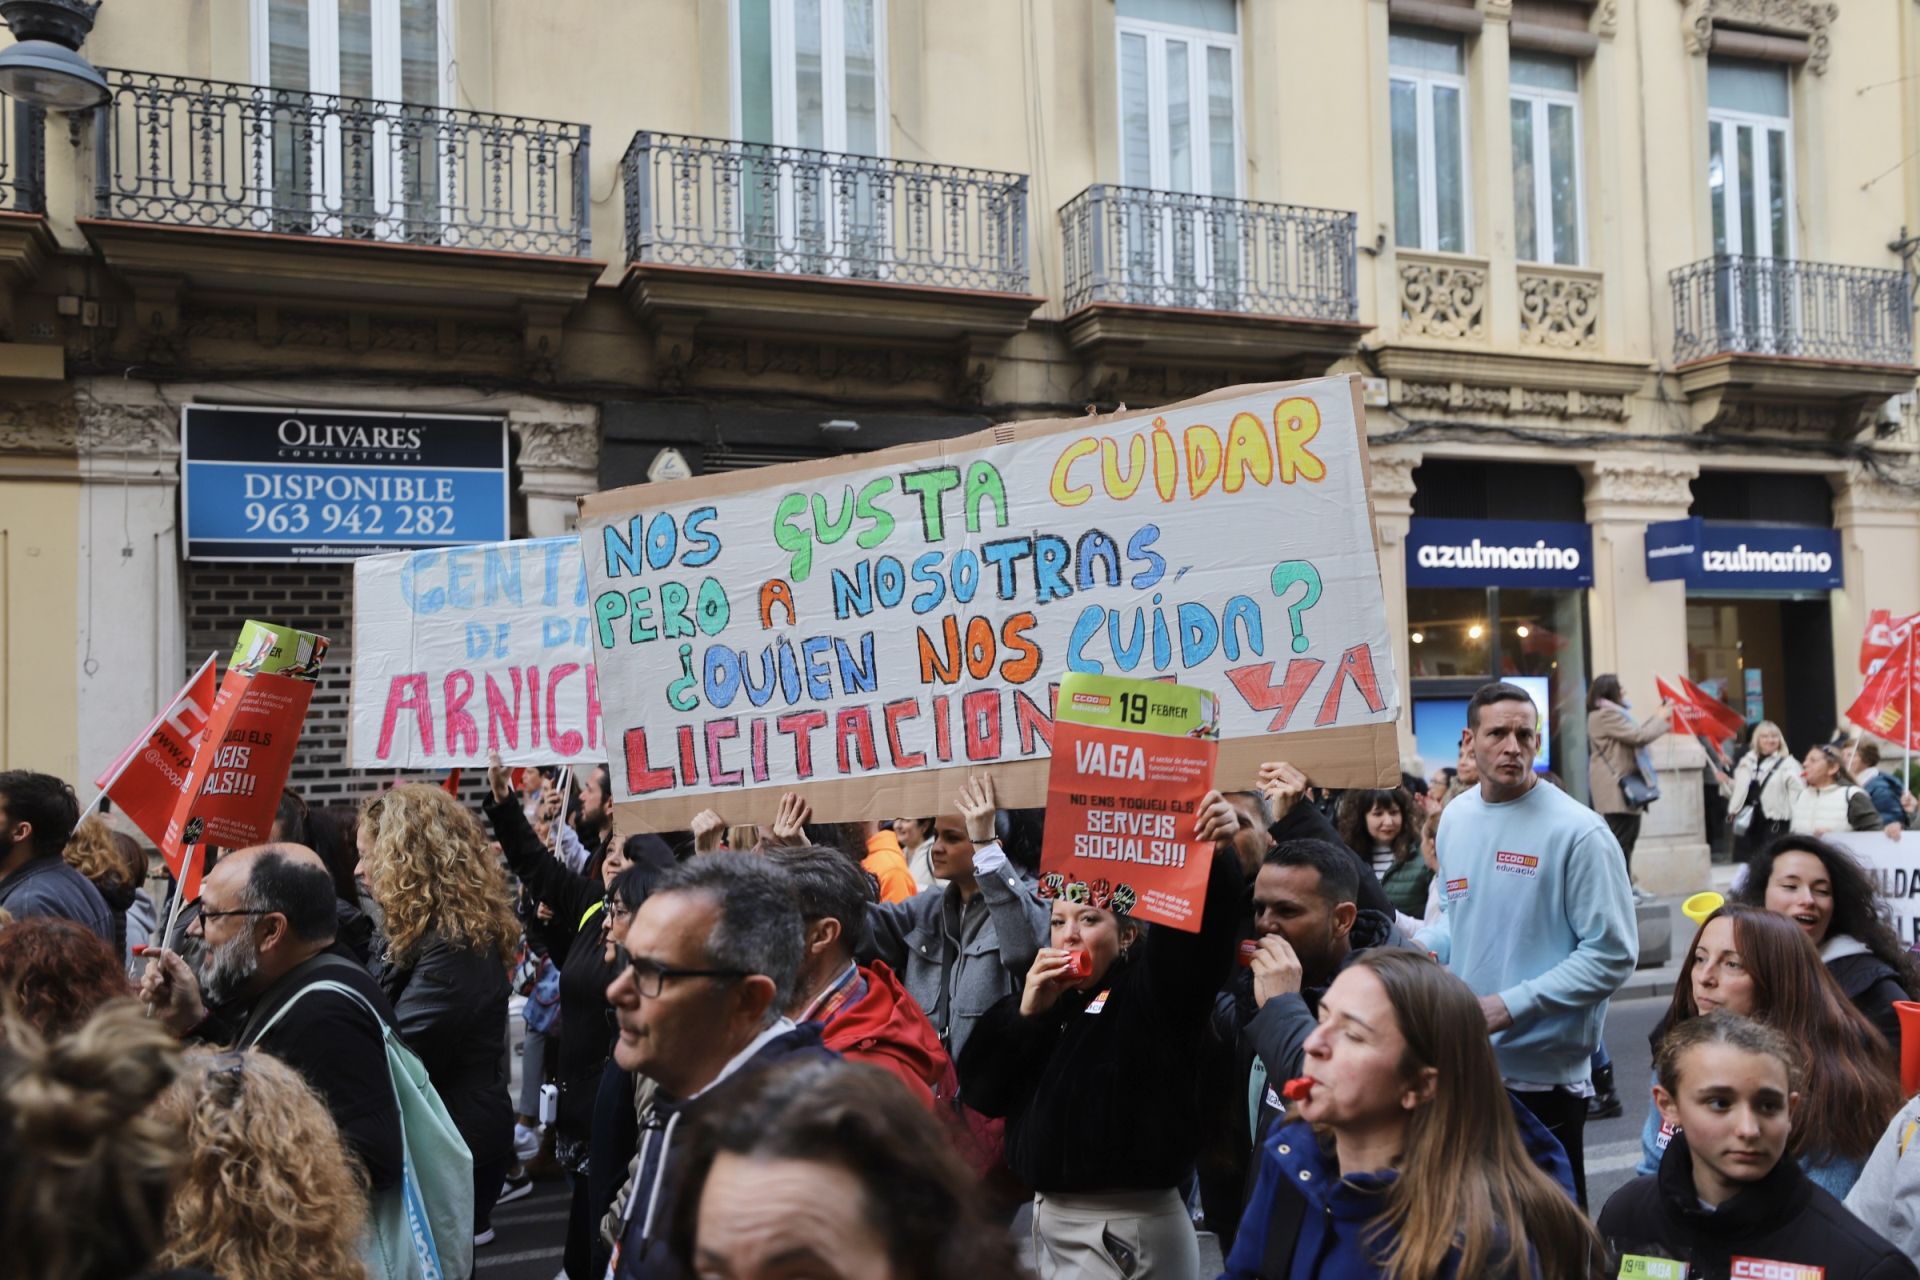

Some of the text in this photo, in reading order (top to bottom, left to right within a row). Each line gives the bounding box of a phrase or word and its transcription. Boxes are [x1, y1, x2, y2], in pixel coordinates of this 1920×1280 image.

[278, 419, 421, 449] OLIVARES
[278, 449, 421, 461] CONSULTORES
[244, 473, 455, 502] DISPONIBLE
[603, 396, 1326, 582] NOS GUSTA CUIDAR
[245, 502, 456, 535] 963 942 282
[1418, 539, 1580, 571] azulmarino
[595, 576, 730, 648] PERO
[758, 578, 796, 630] A
[917, 611, 1043, 684] NOS
[1066, 560, 1323, 675] CUIDA?
[465, 621, 510, 660] DE
[623, 643, 1388, 795] LICITACION YA
[1073, 692, 1188, 725] CCOO 19 FEBRER
[249, 730, 272, 746] ELS
[145, 748, 187, 788] @ccoop
[214, 745, 251, 769] VEIS
[1075, 740, 1146, 781] VAGA
[202, 771, 256, 796] ALS!!!
[1070, 793, 1087, 806] NO
[1092, 795, 1115, 808] ENS
[1087, 809, 1176, 840] SERVEIS
[1074, 834, 1186, 869] SOCIALS!!!
[1498, 853, 1525, 864] CCOO
[1496, 863, 1536, 876] educació
[1624, 1259, 1633, 1273] 19
[1735, 1260, 1795, 1279] CCOO
